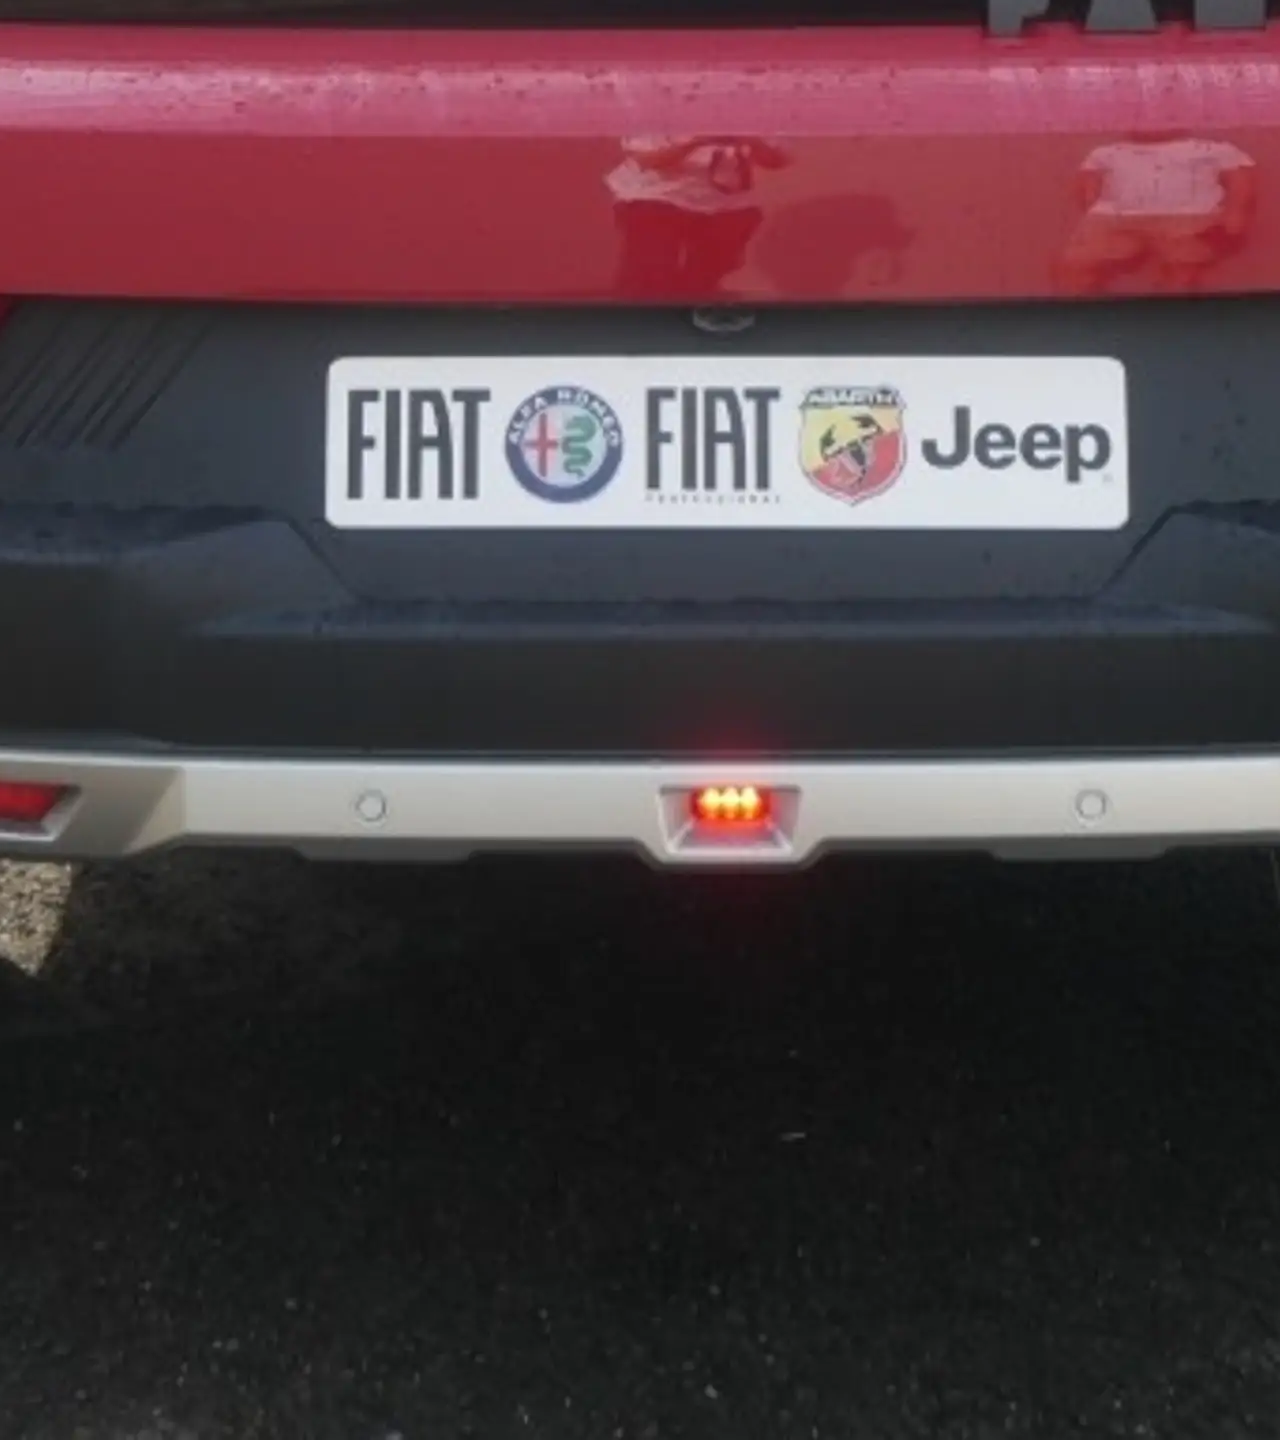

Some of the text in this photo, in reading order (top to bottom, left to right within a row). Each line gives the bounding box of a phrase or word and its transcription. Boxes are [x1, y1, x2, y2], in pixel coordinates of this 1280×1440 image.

[347, 388, 491, 500] FIAT
[646, 386, 780, 490] FIAT
[921, 405, 1112, 483] Jeep
